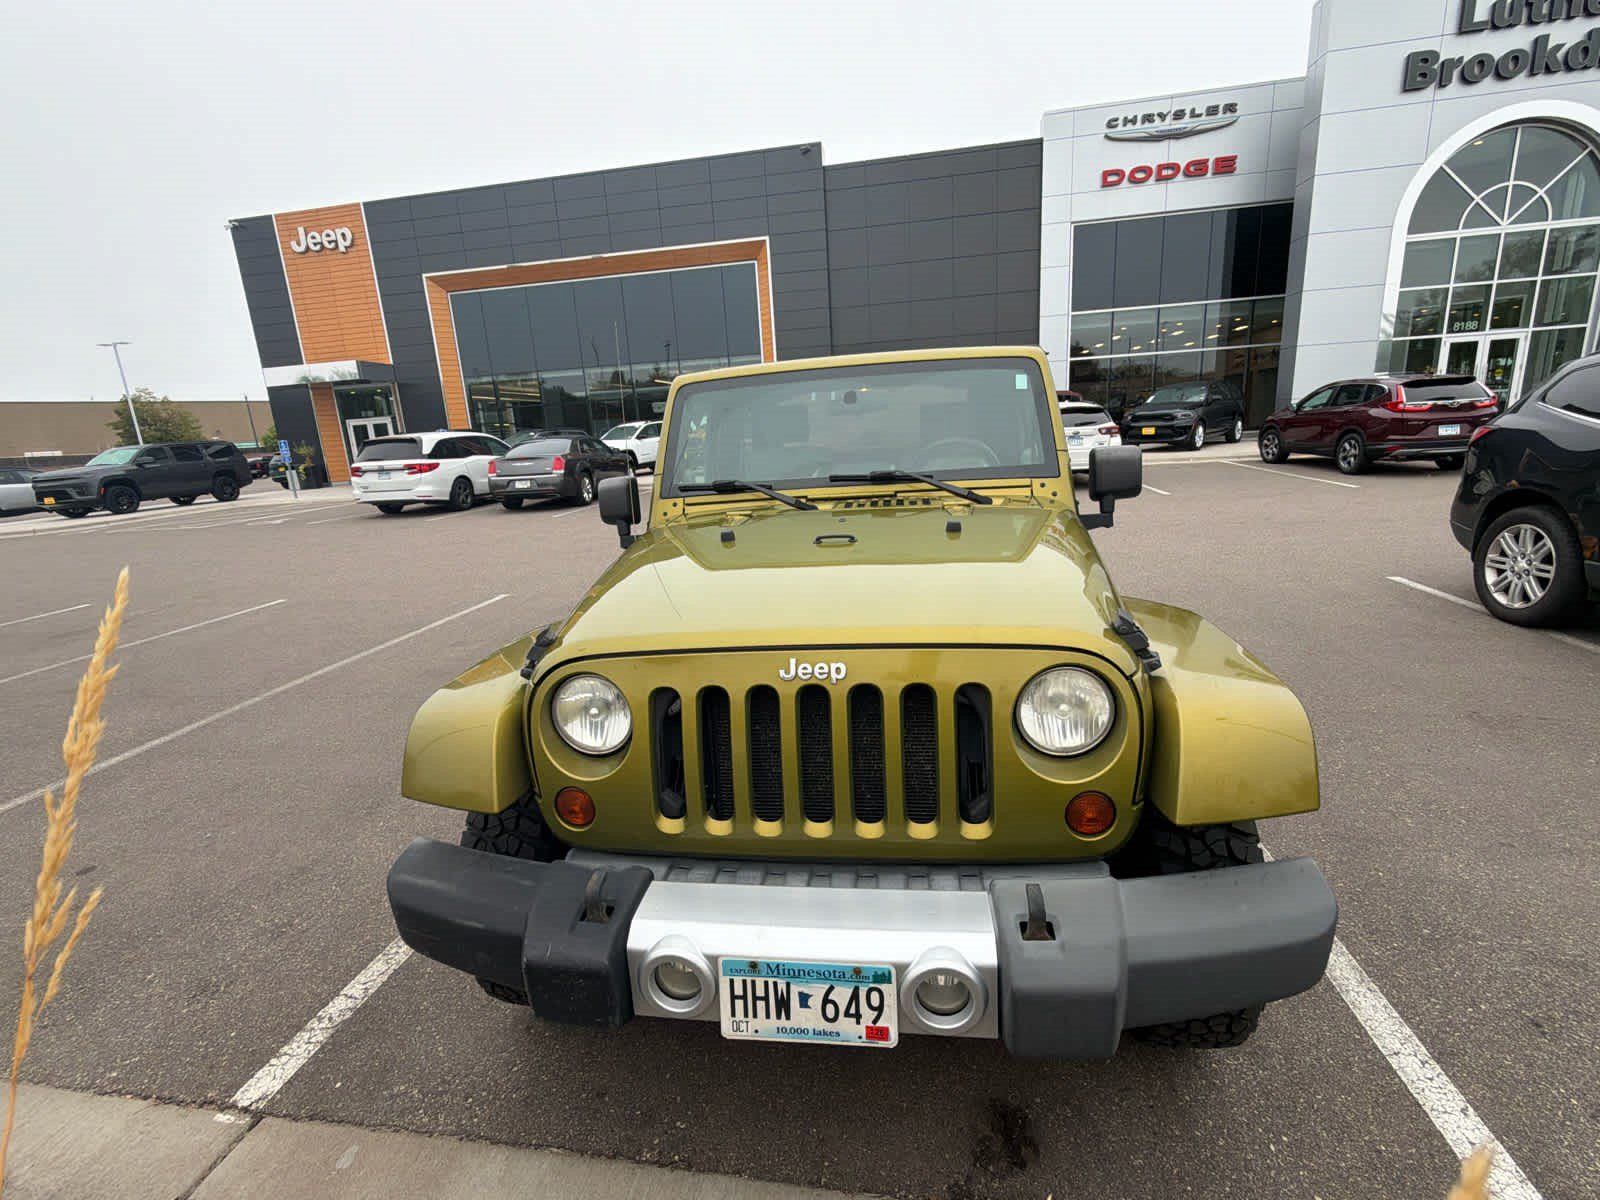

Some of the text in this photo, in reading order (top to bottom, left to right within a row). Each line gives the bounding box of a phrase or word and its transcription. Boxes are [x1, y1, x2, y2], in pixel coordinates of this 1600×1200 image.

[1105, 102, 1238, 129] CHRYSLER
[1101, 155, 1238, 188] DODGE
[290, 226, 353, 253] Jeep
[1453, 321, 1478, 331] 8188
[779, 657, 847, 685] Jeep
[729, 978, 885, 1026] HHW 649
[732, 1020, 750, 1033] OCT
[775, 1026, 841, 1038] 10,000 lakes
